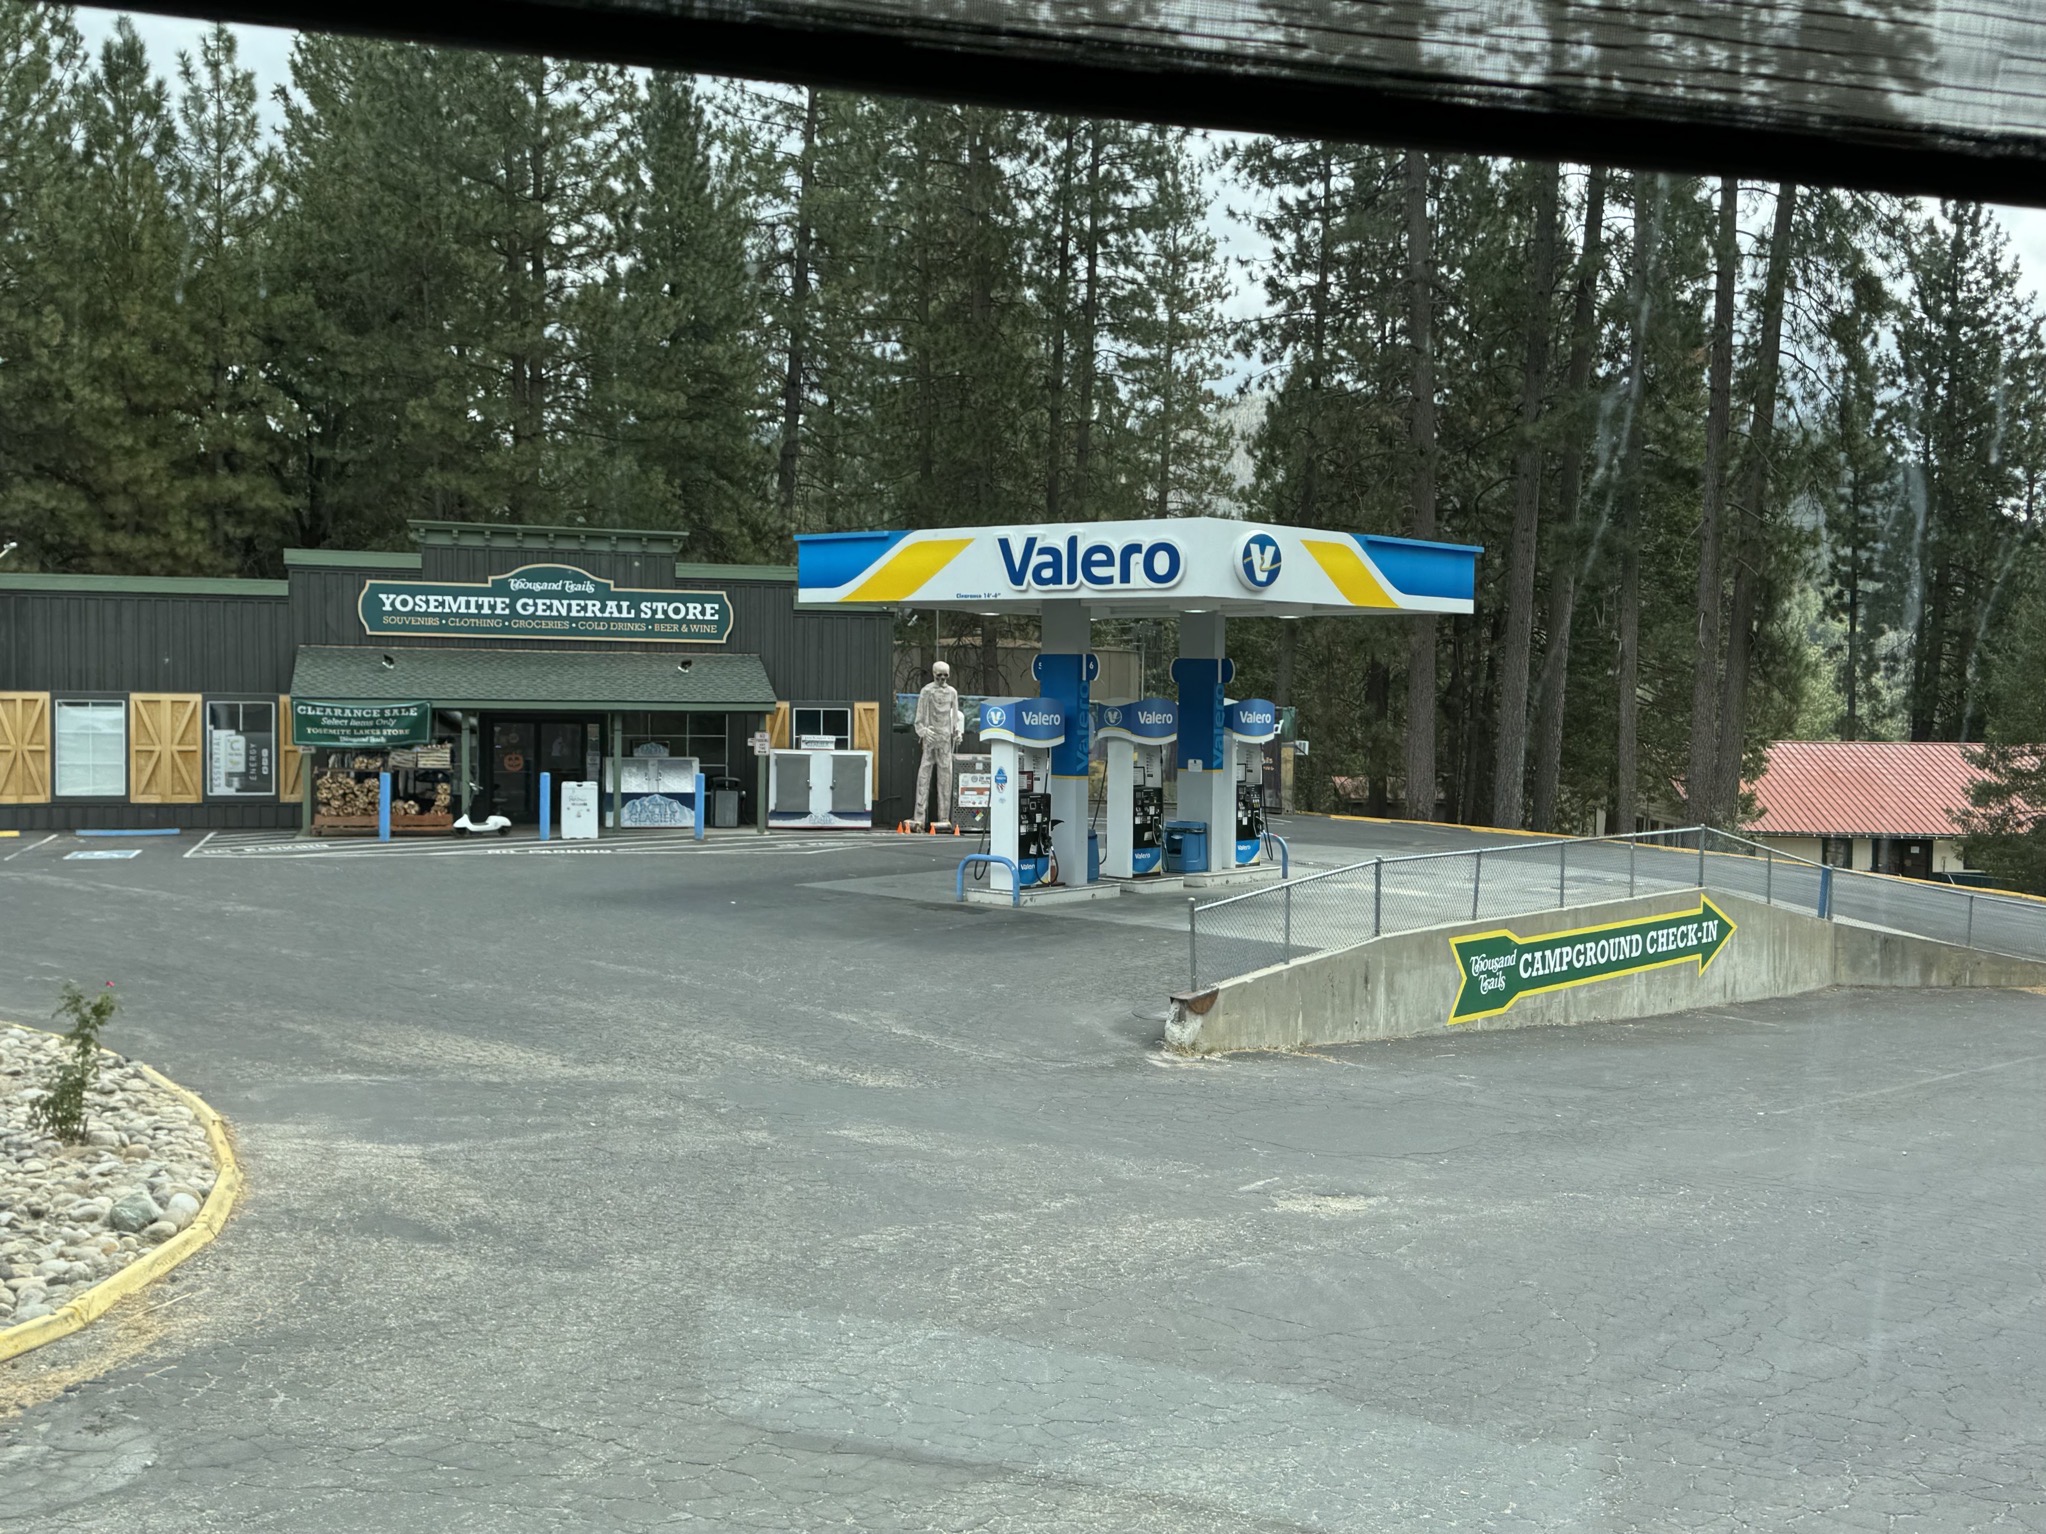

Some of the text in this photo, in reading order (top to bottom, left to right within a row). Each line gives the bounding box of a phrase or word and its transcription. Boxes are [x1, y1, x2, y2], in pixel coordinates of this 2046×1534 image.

[997, 535, 1181, 586] Valero
[508, 578, 595, 594] Thousand Trails
[378, 593, 719, 620] YOSEMITE GENERAL STORE
[382, 615, 718, 634] SOUVENIRS CLOTHING GROCERIES COLD DRINKS BEER & WINE
[1089, 661, 1094, 670] 6
[297, 705, 418, 718] CLEARANCE SALE
[1021, 711, 1061, 726] Valero
[1137, 711, 1173, 725] Valero
[1239, 711, 1272, 724] Valero
[321, 717, 348, 726] Select
[375, 718, 397, 728] Only
[1076, 682, 1090, 772] Valero
[1212, 684, 1225, 769] Valero
[306, 727, 410, 737] YOSEMITE LAKES STORE
[213, 735, 222, 788] ESSENTIAL
[249, 743, 257, 781] ENERGY
[629, 800, 679, 814] ARCTIC
[629, 813, 680, 823] GLACIER
[1519, 920, 1719, 979] CAMPGROUND CHECK-IN
[1469, 948, 1518, 977] Thousand
[1478, 970, 1506, 995] Trails
